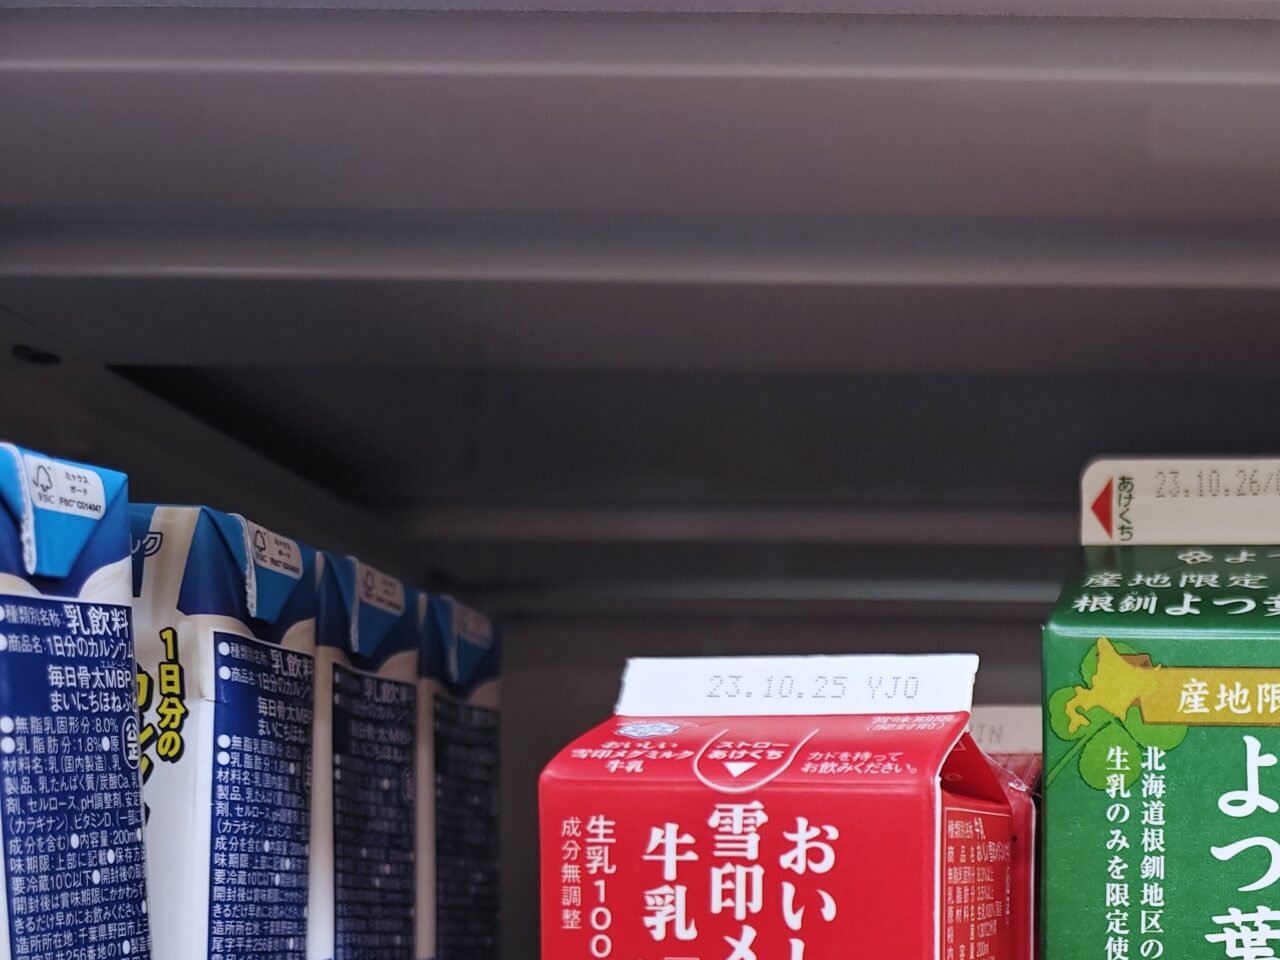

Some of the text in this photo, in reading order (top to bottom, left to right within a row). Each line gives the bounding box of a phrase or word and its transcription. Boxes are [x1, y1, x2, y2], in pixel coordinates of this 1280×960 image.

[1118, 475, 1134, 542] あけくち
[1081, 572, 1270, 589] 産地限定
[157, 628, 190, 762] 1日分の
[706, 675, 847, 698] 23.10.25
[707, 750, 785, 760] あけくち
[716, 741, 791, 749] ストロー
[605, 760, 644, 773] 牛乳
[807, 752, 905, 762] カドを持って
[801, 762, 919, 775] お飲みください。
[1139, 746, 1167, 960] 北海道根釧地区の
[561, 816, 582, 930] 成分無調整
[642, 822, 700, 942] 牛乳
